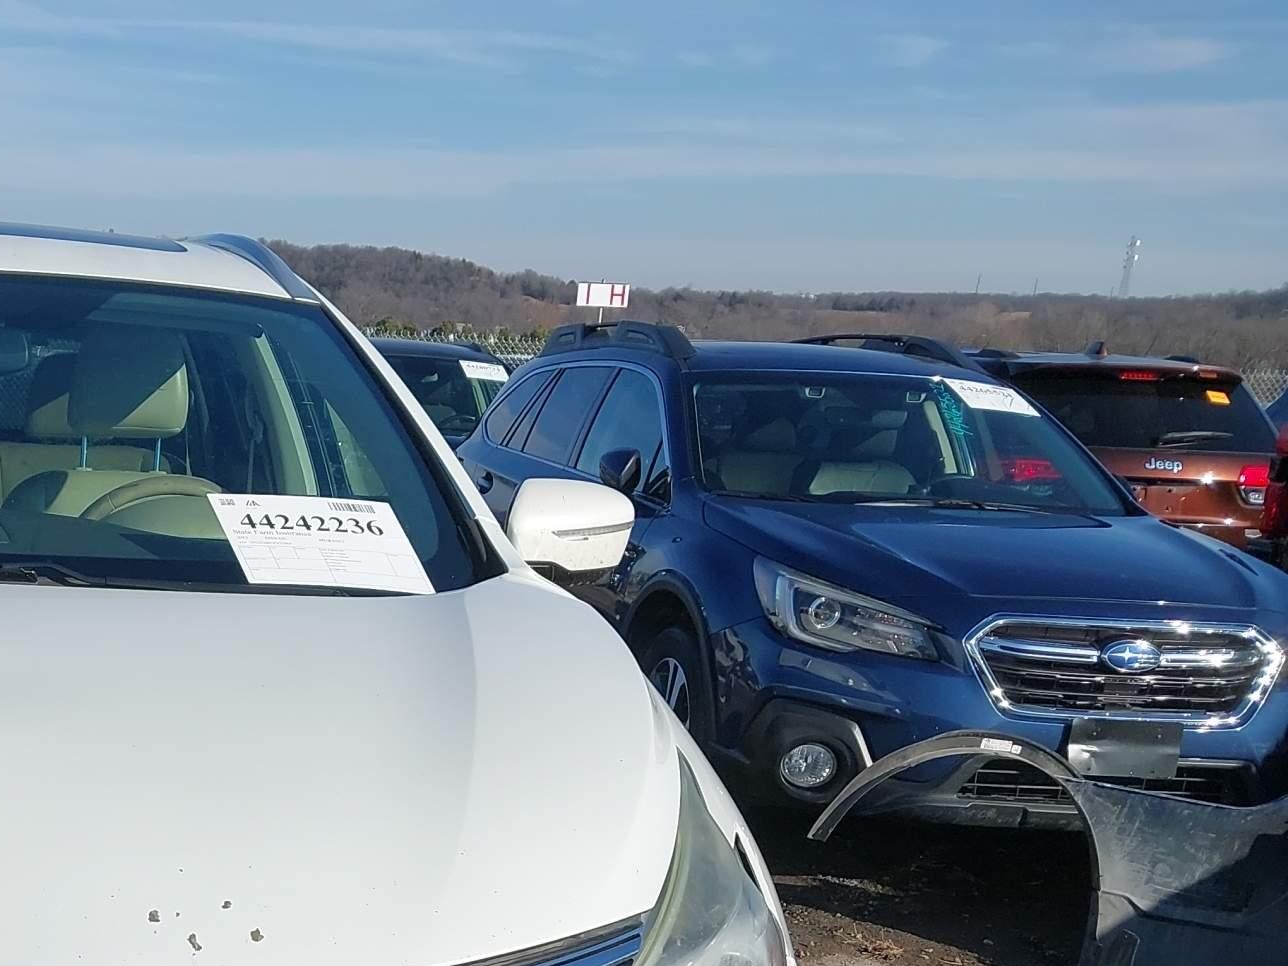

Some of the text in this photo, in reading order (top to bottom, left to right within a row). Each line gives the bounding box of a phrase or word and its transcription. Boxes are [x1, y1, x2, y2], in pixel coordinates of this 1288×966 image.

[609, 284, 626, 306] H
[1144, 457, 1183, 474] Jeep
[240, 513, 385, 537] 44242236
